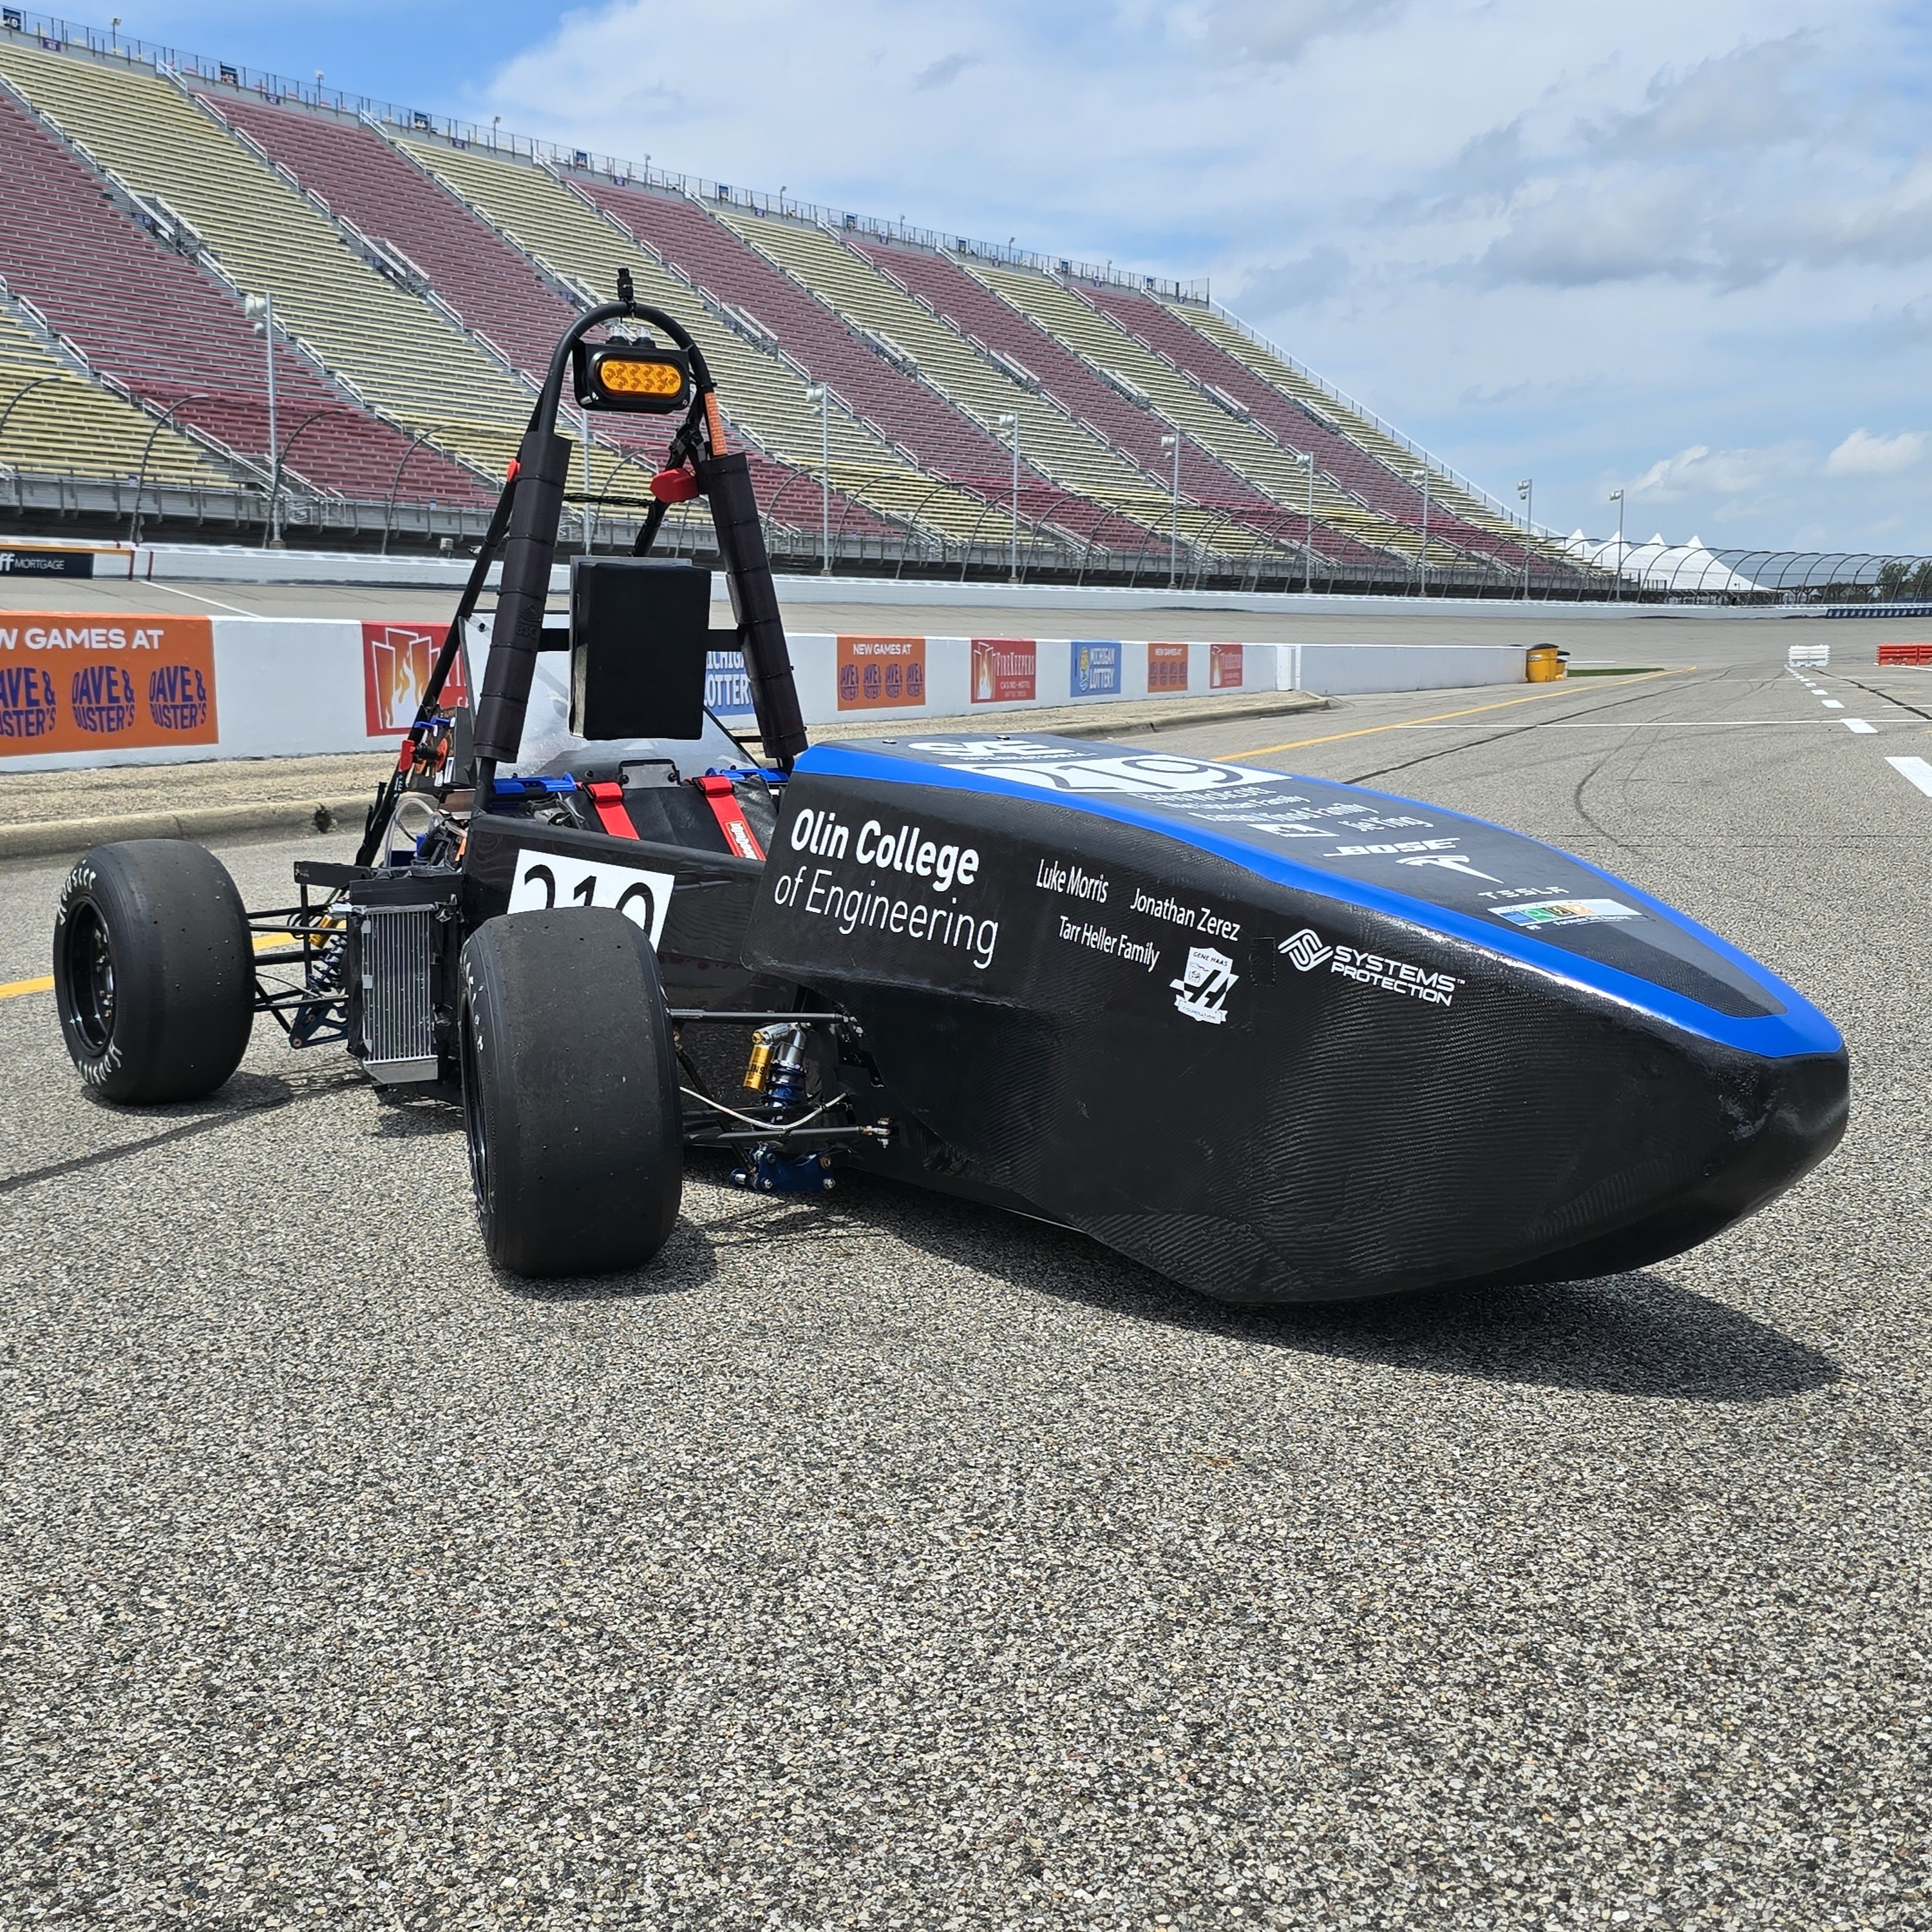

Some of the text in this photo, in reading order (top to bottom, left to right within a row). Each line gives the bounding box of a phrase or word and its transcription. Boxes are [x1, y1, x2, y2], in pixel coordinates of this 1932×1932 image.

[15, 558, 65, 570] MORTGAGE
[24, 629, 126, 649] GAMES
[131, 629, 164, 649] AT
[853, 644, 912, 655] NEW GAMES AT
[42, 670, 57, 706] &
[71, 666, 135, 705] DAVE &
[149, 665, 207, 702] DAVE &
[72, 705, 135, 733] BUSTER'S
[149, 703, 207, 729] BUSTER'S
[907, 740, 1075, 757] SAE
[971, 759, 1244, 790] 219
[791, 809, 980, 891] Olin College
[1323, 838, 1460, 857] BOSE
[1036, 859, 1109, 904] Luke Morris
[1477, 886, 1569, 900] TESLA
[774, 866, 999, 969] of Engineering
[1130, 888, 1241, 942] Jonathan Zerez
[1059, 916, 1160, 972] Tarr Heller Family
[1193, 951, 1229, 967] GENE HAAS
[1331, 961, 1452, 1007] PROTECTION
